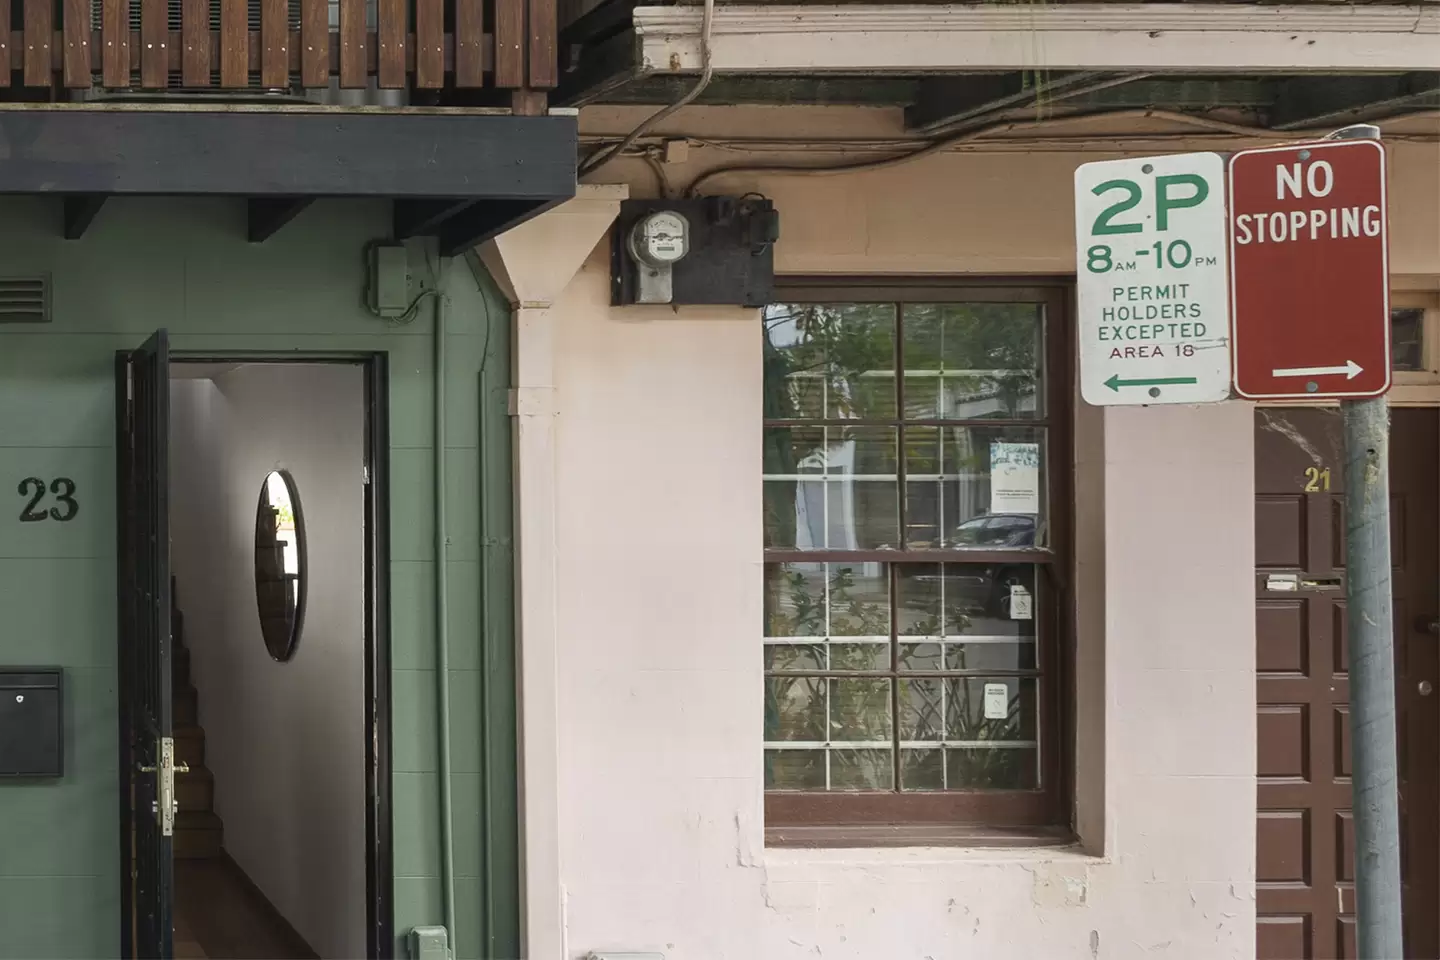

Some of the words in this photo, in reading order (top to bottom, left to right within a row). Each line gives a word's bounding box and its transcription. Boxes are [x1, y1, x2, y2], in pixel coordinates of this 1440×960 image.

[1276, 160, 1333, 200] NO
[1091, 173, 1209, 236] 2P
[1236, 205, 1380, 244] STOPPING
[1113, 283, 1190, 302] PERMIT
[1102, 302, 1202, 322] HOLDERS
[1098, 322, 1206, 341] EXCEPTED
[1109, 345, 1164, 359] AREA
[1175, 344, 1195, 357] 18
[1304, 467, 1331, 492] 21
[17, 476, 80, 522] 23
